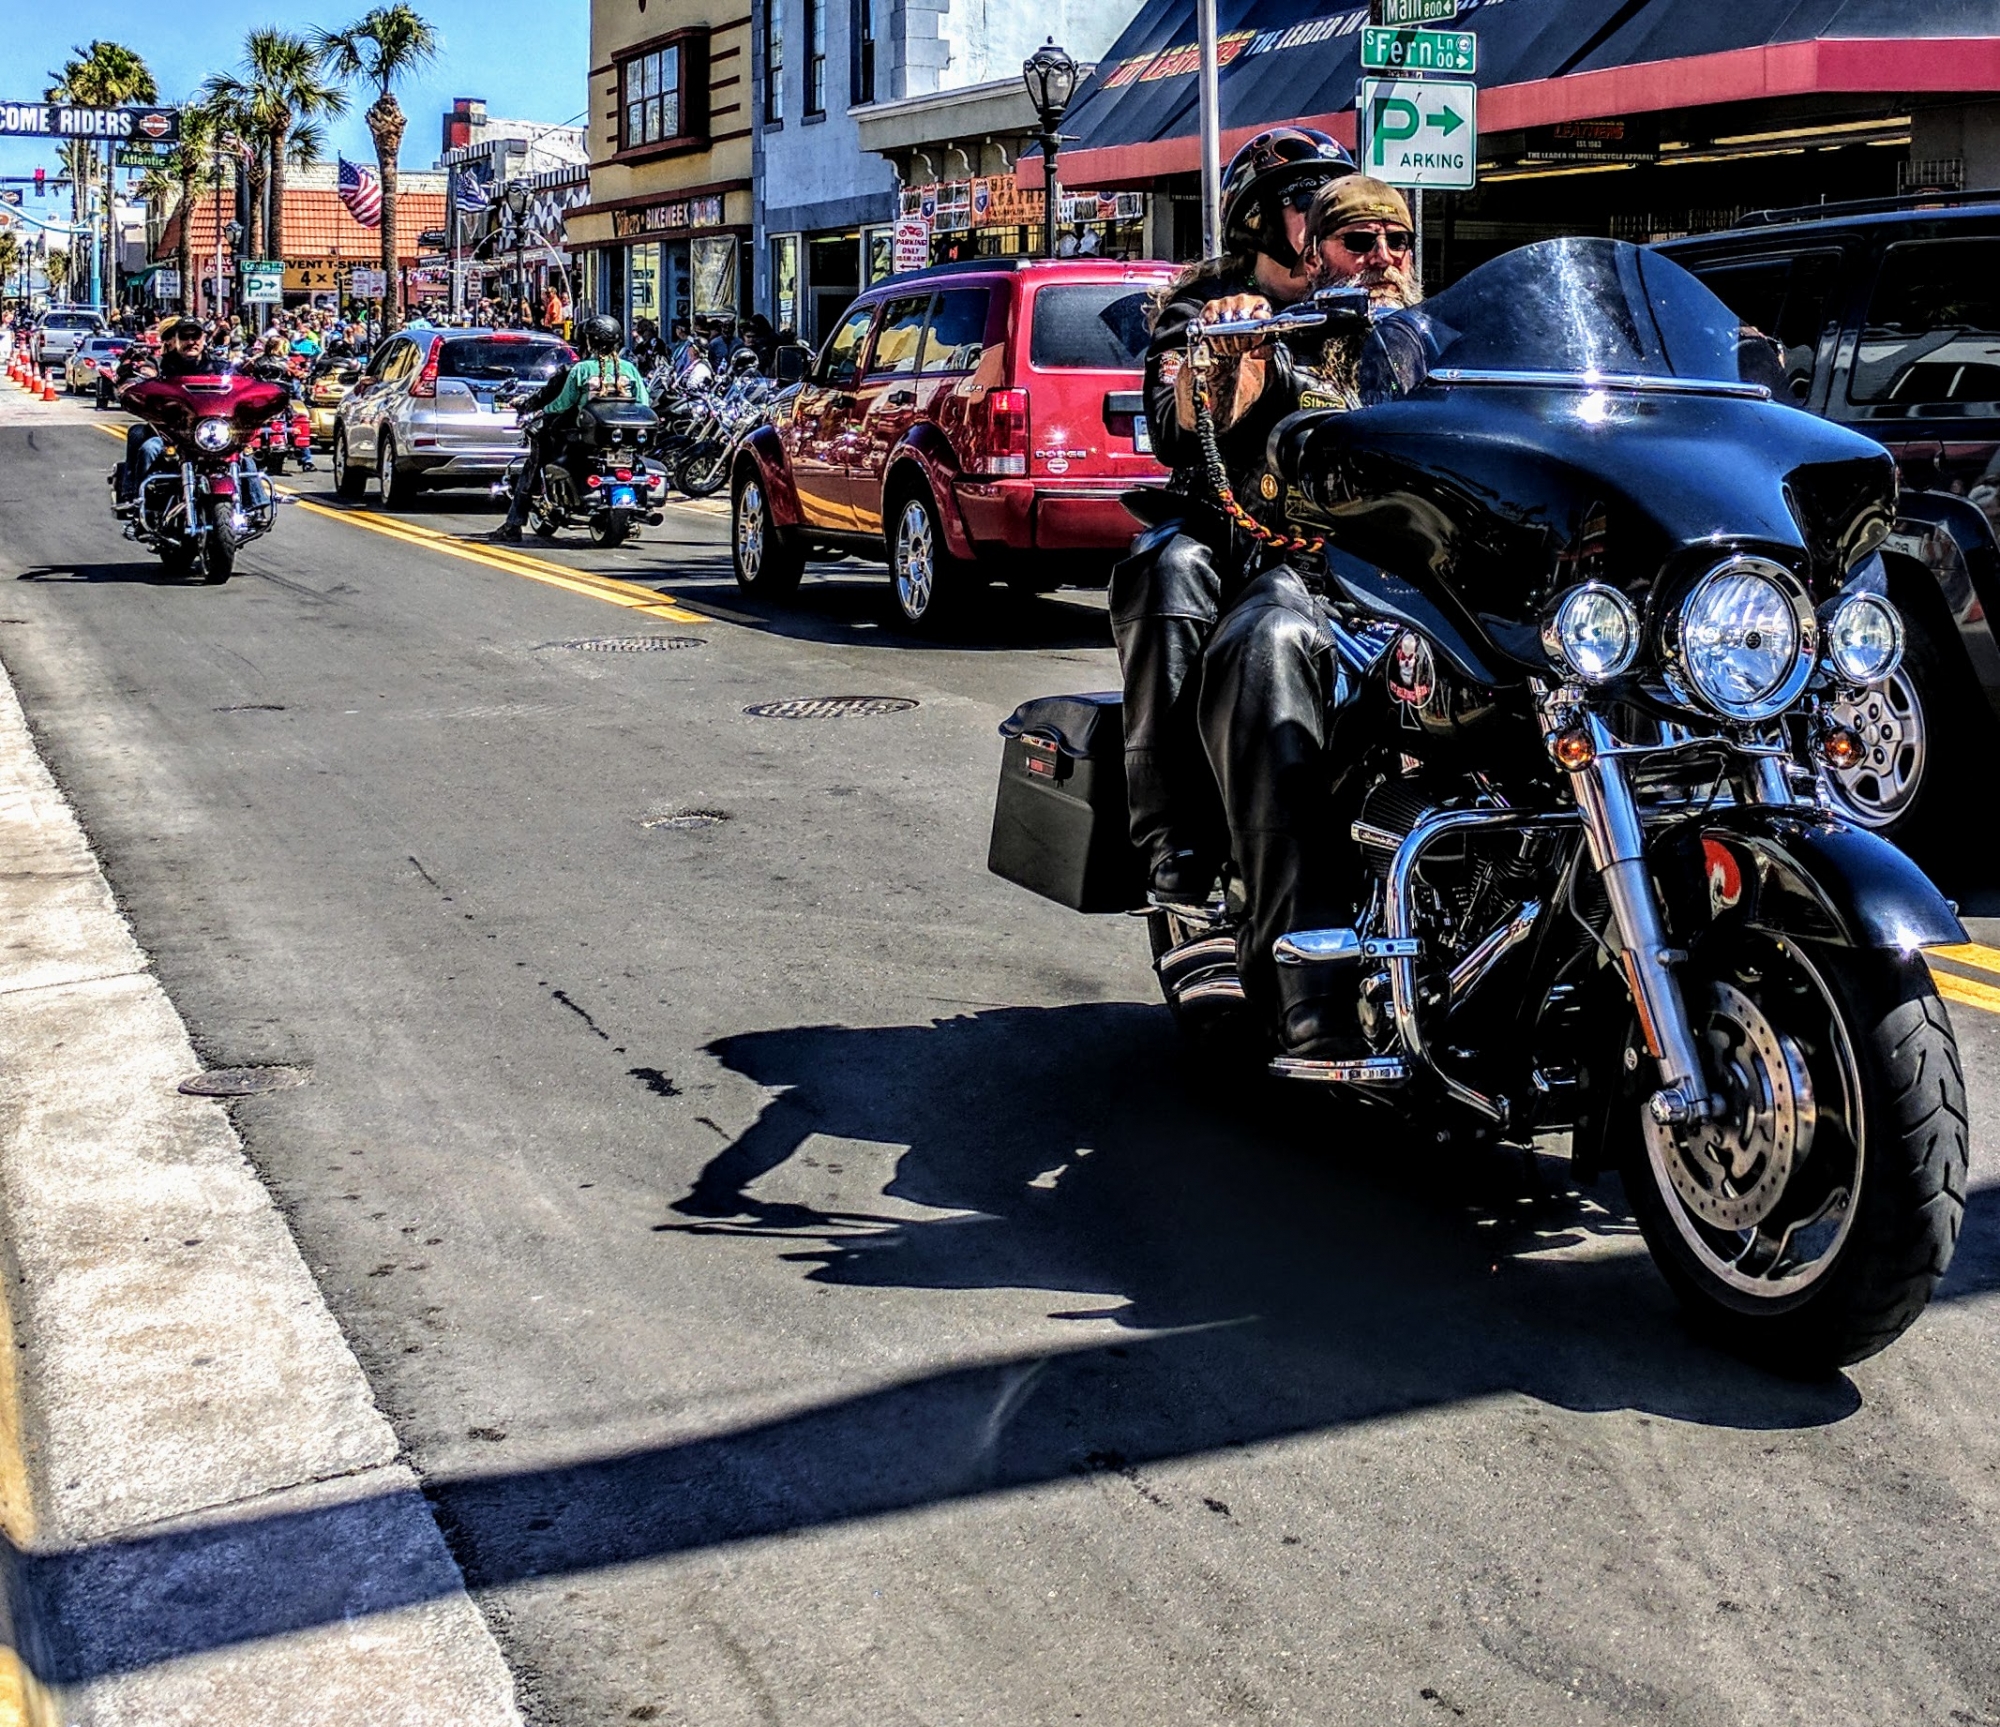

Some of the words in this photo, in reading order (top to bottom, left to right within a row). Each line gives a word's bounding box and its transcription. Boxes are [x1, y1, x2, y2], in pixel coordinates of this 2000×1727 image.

[1424, 1, 1443, 17] 800
[1274, 15, 1345, 51] LEADER
[1366, 30, 1375, 46] S
[1376, 33, 1432, 66] Fern
[1437, 34, 1453, 50] Ln
[60, 108, 133, 137] RIDERS
[121, 154, 166, 167] Atlantic
[1577, 152, 1623, 160] MOTORCYCLE
[896, 238, 928, 246] PARKING
[902, 247, 920, 255] ONLY
[301, 271, 311, 286] 4
[1035, 449, 1087, 459] DODGE
